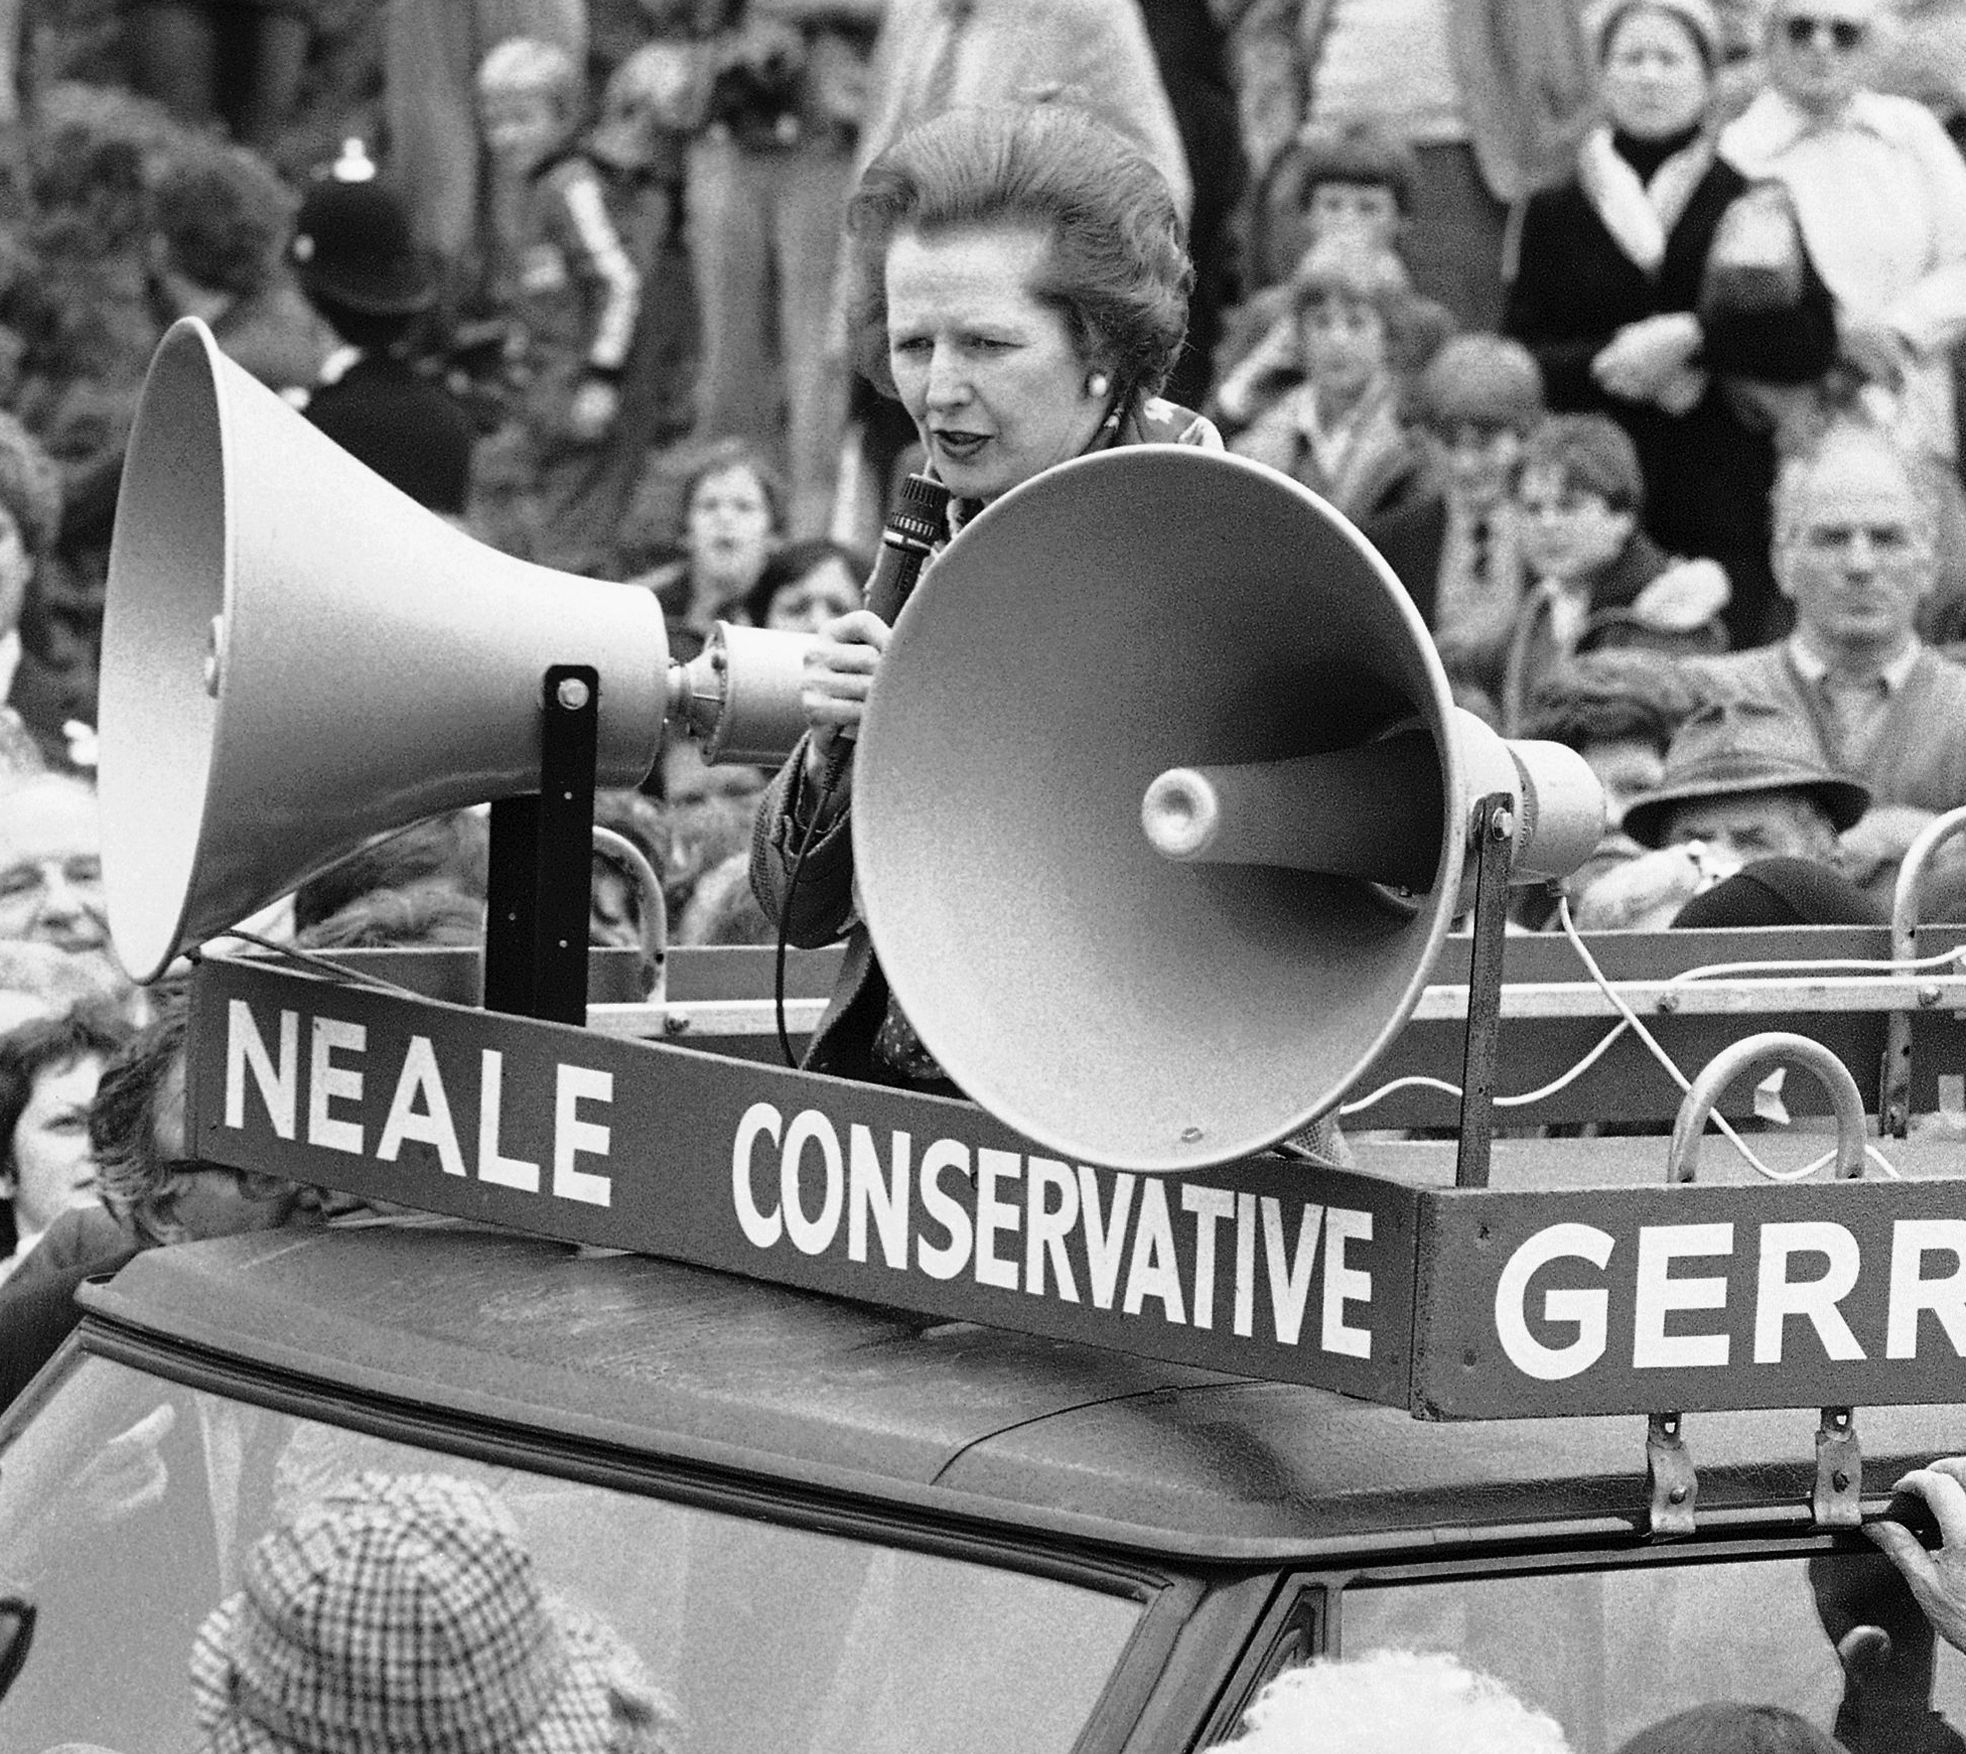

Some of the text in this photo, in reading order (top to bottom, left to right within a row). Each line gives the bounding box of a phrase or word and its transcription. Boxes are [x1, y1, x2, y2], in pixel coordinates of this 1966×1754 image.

[225, 1000, 1373, 1360] NEALE CONSERVATIVE
[1495, 1219, 1966, 1380] GERR
